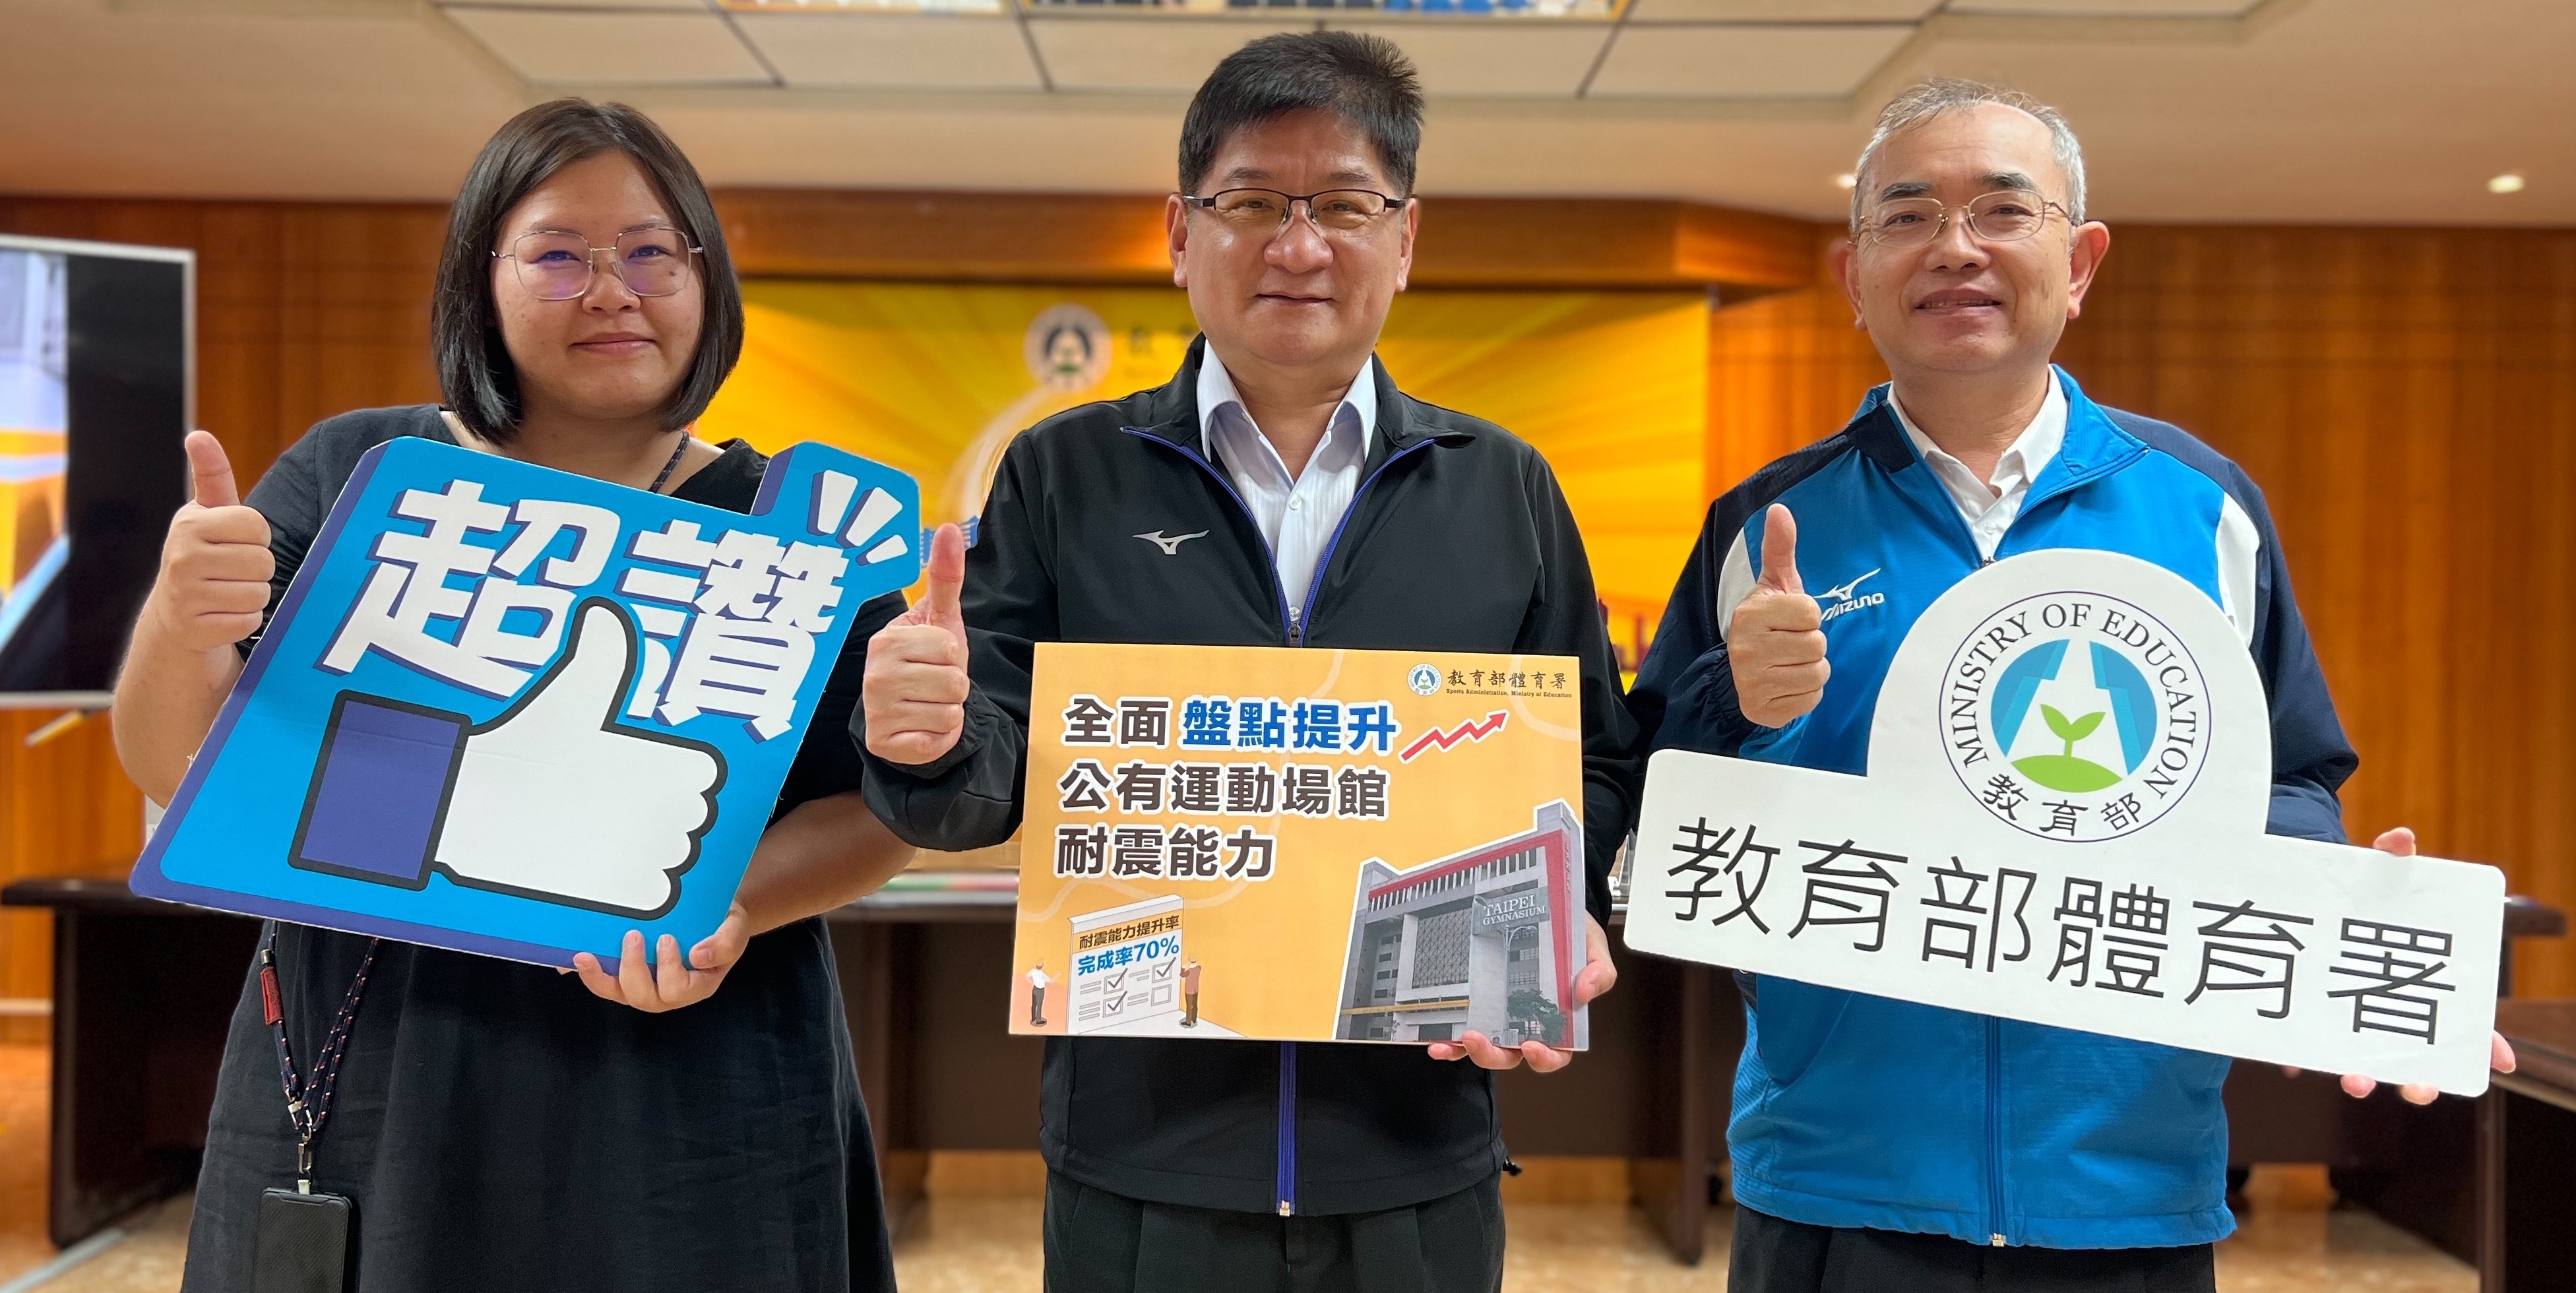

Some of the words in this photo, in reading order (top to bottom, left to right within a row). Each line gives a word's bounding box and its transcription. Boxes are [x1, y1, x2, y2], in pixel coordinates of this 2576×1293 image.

[314, 480, 850, 743] 超讚
[1821, 592, 1885, 621] MIZUNO
[1447, 669, 1567, 690] 教育部體育署
[1951, 611, 2032, 769] MINISTRY
[2042, 603, 2092, 629] OF
[2098, 608, 2197, 800] EDUCATION
[1059, 762, 1387, 817] 公有運動場館
[1982, 773, 2142, 836] 教育部
[1056, 825, 1274, 879] 耐震能力
[1482, 905, 1546, 926] GYMNASIUM
[1483, 894, 1536, 917] TAIPEI
[1079, 914, 1179, 950] 耐震能力提升率
[1664, 816, 2457, 1046] 教育部體育署
[1078, 935, 1179, 976] 完成率70%
